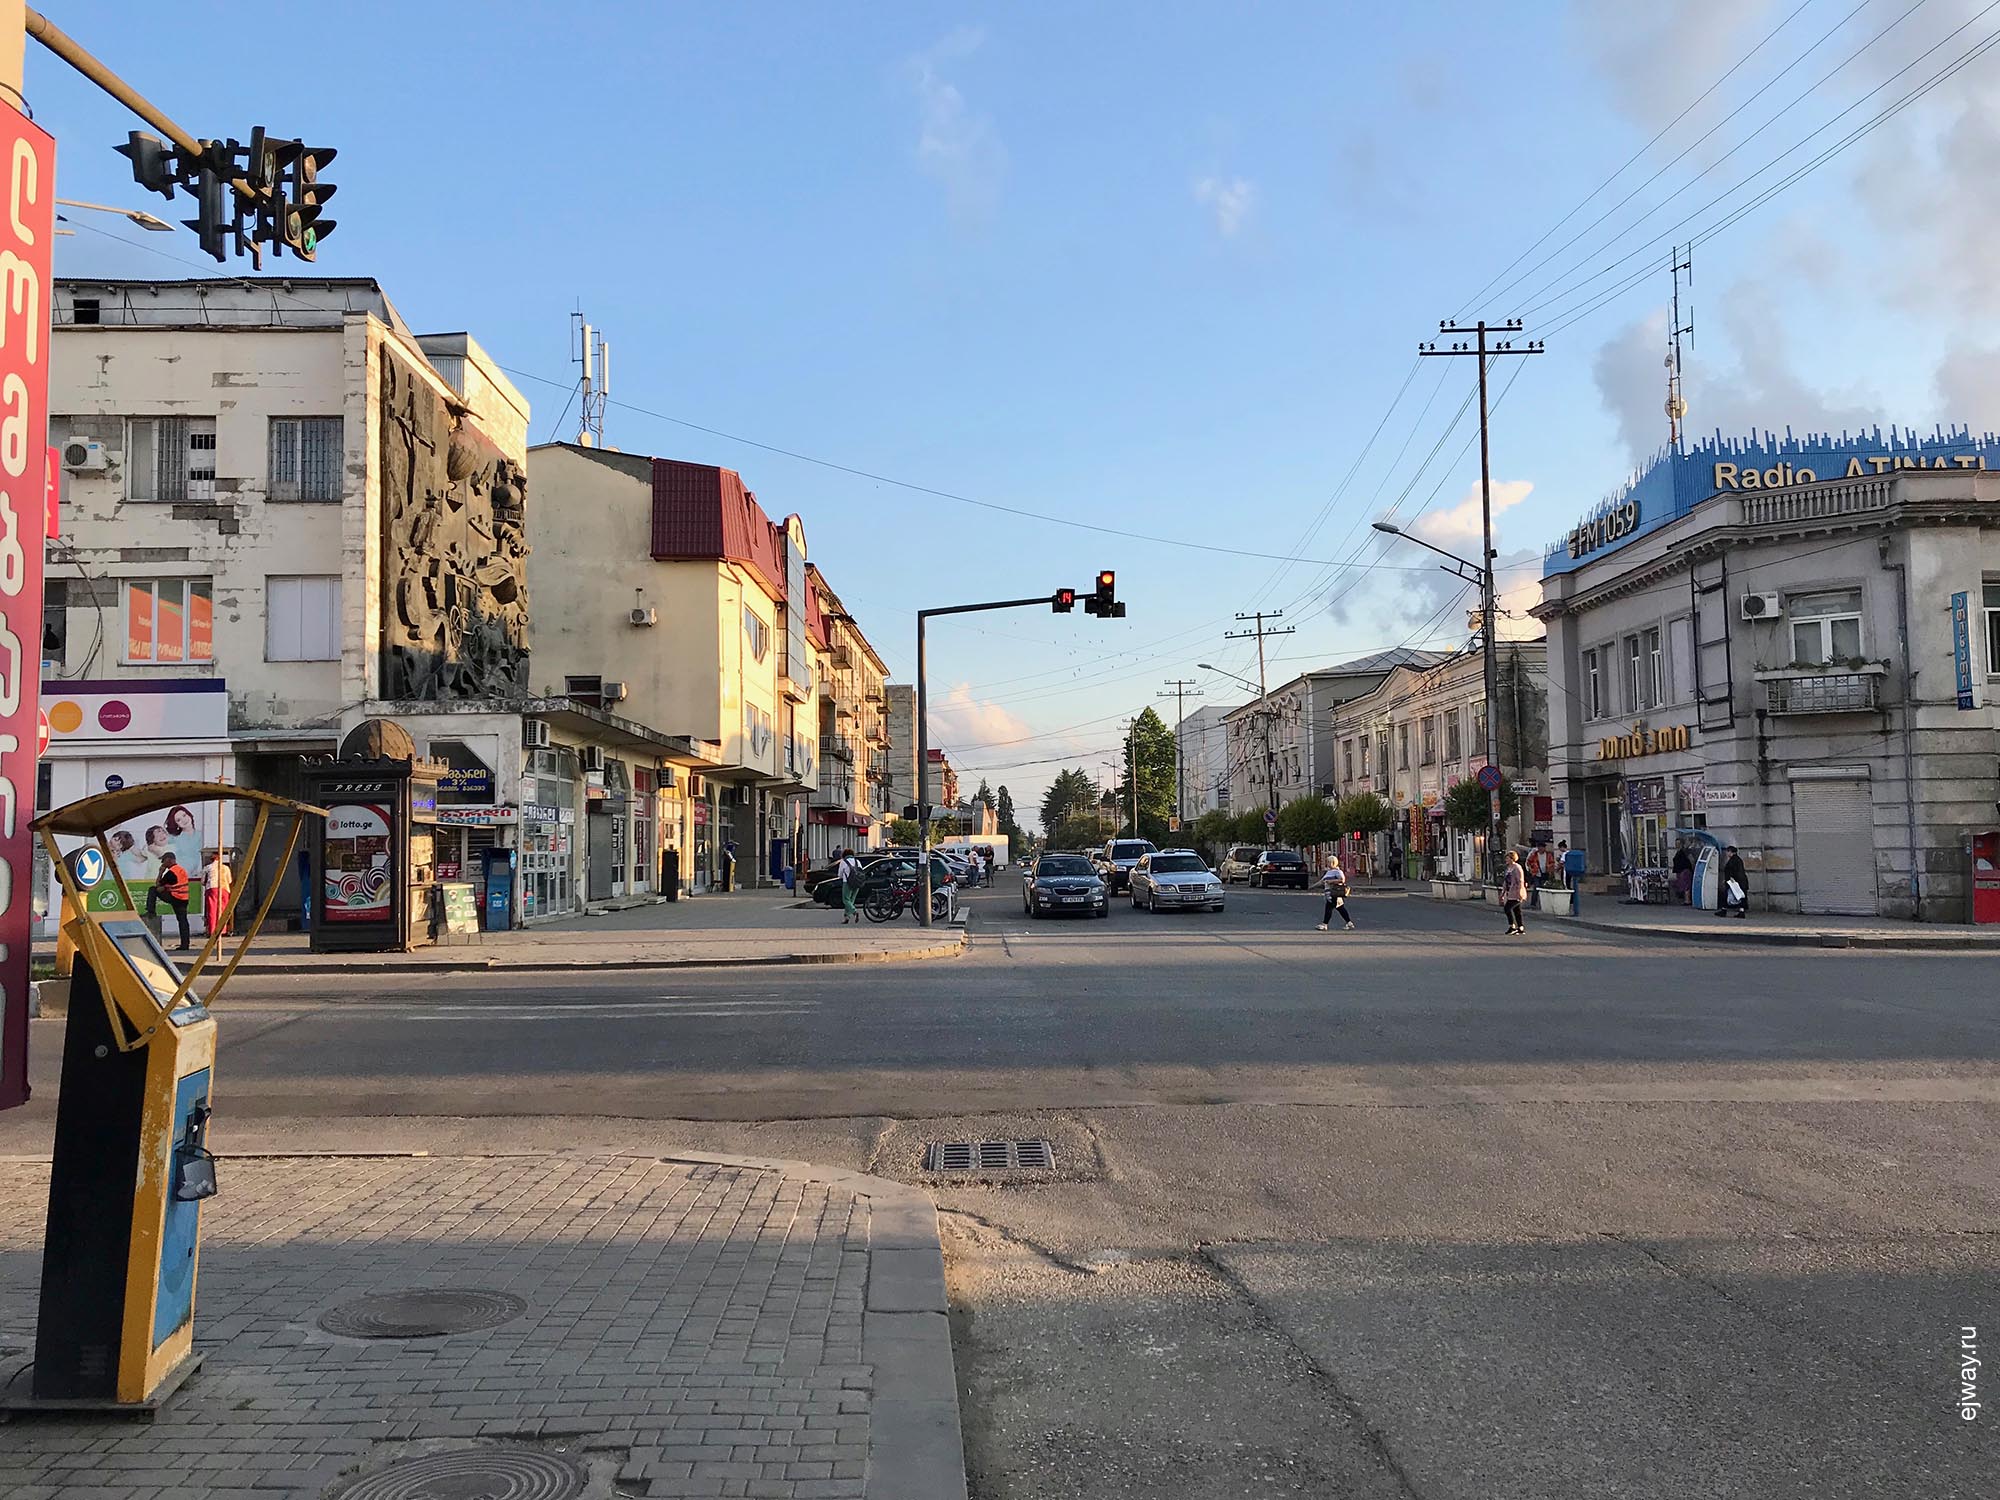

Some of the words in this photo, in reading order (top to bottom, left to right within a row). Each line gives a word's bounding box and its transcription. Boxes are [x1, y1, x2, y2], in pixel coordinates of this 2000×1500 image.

[1714, 461, 1817, 489] Radio
[1578, 520, 1599, 555] FM
[335, 783, 382, 792] PRESS
[340, 820, 373, 830] lotto.ge
